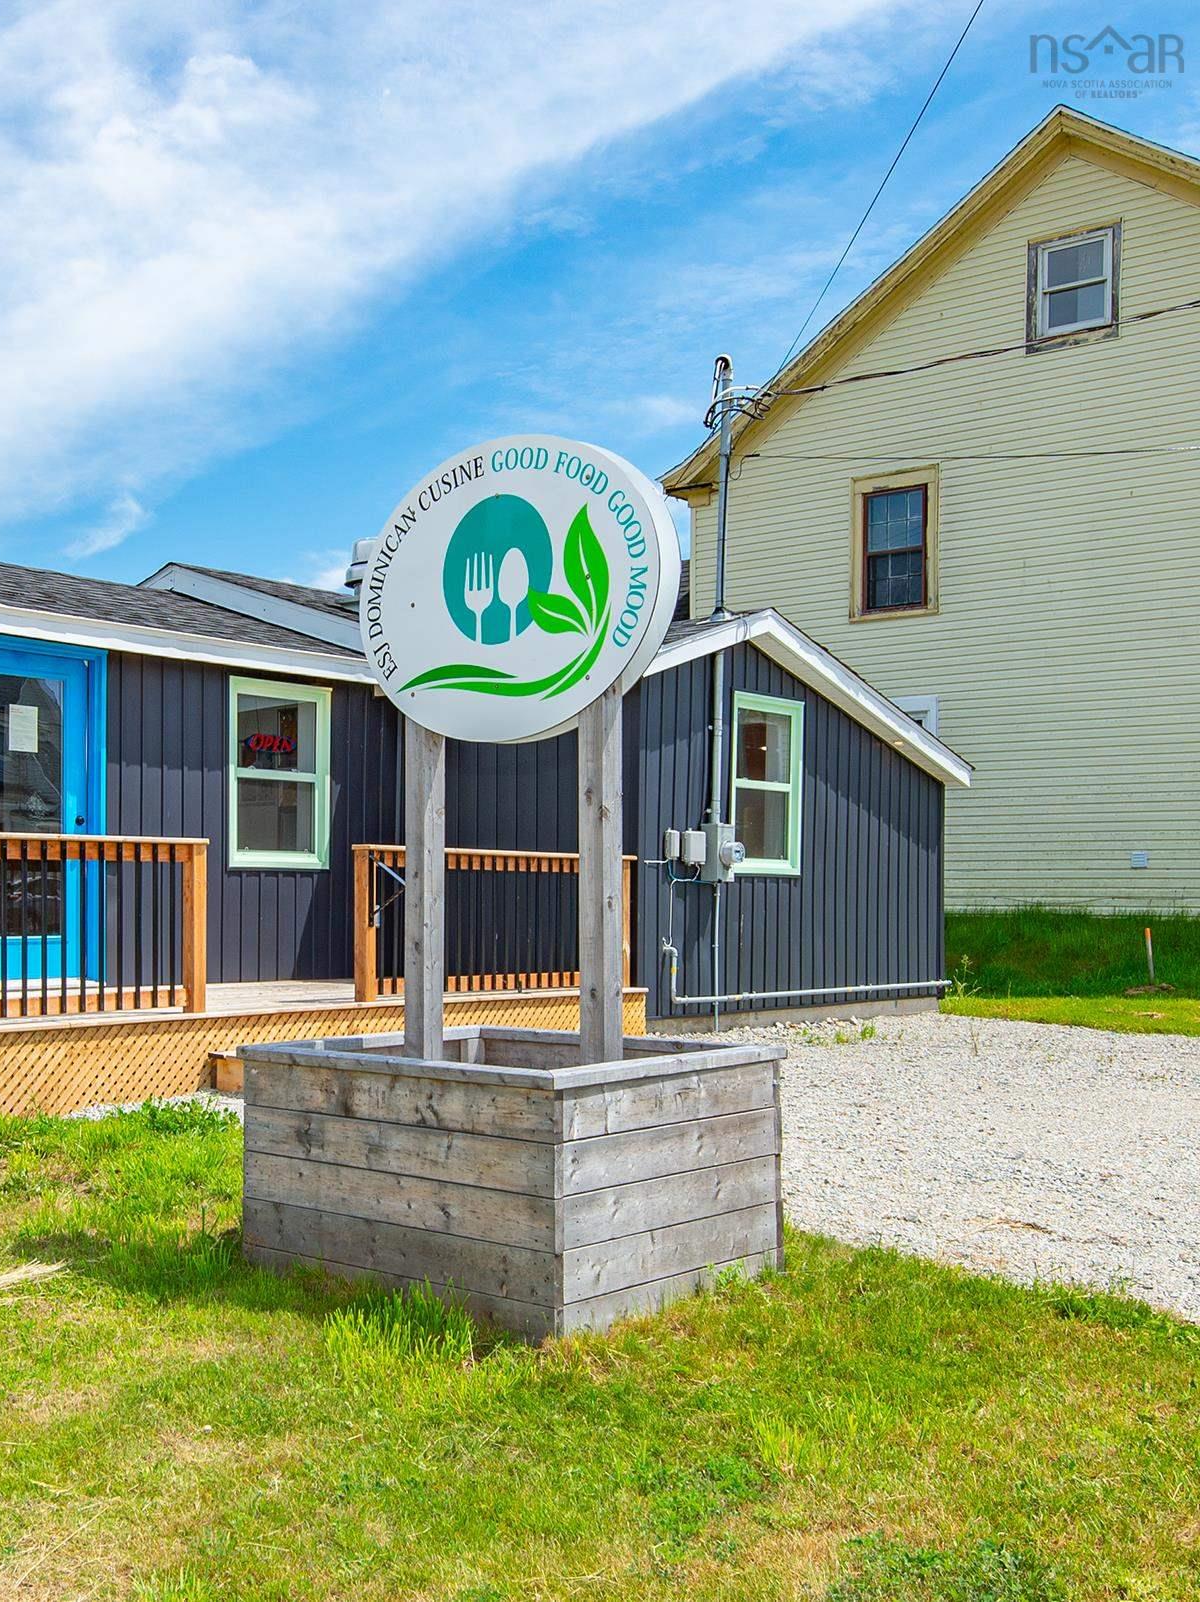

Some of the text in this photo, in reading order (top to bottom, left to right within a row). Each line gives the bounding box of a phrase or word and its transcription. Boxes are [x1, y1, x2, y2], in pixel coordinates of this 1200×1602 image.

[366, 446, 650, 682] ESJ DOMINICAN CUSINE GOOD FOOD GOOD MOOD
